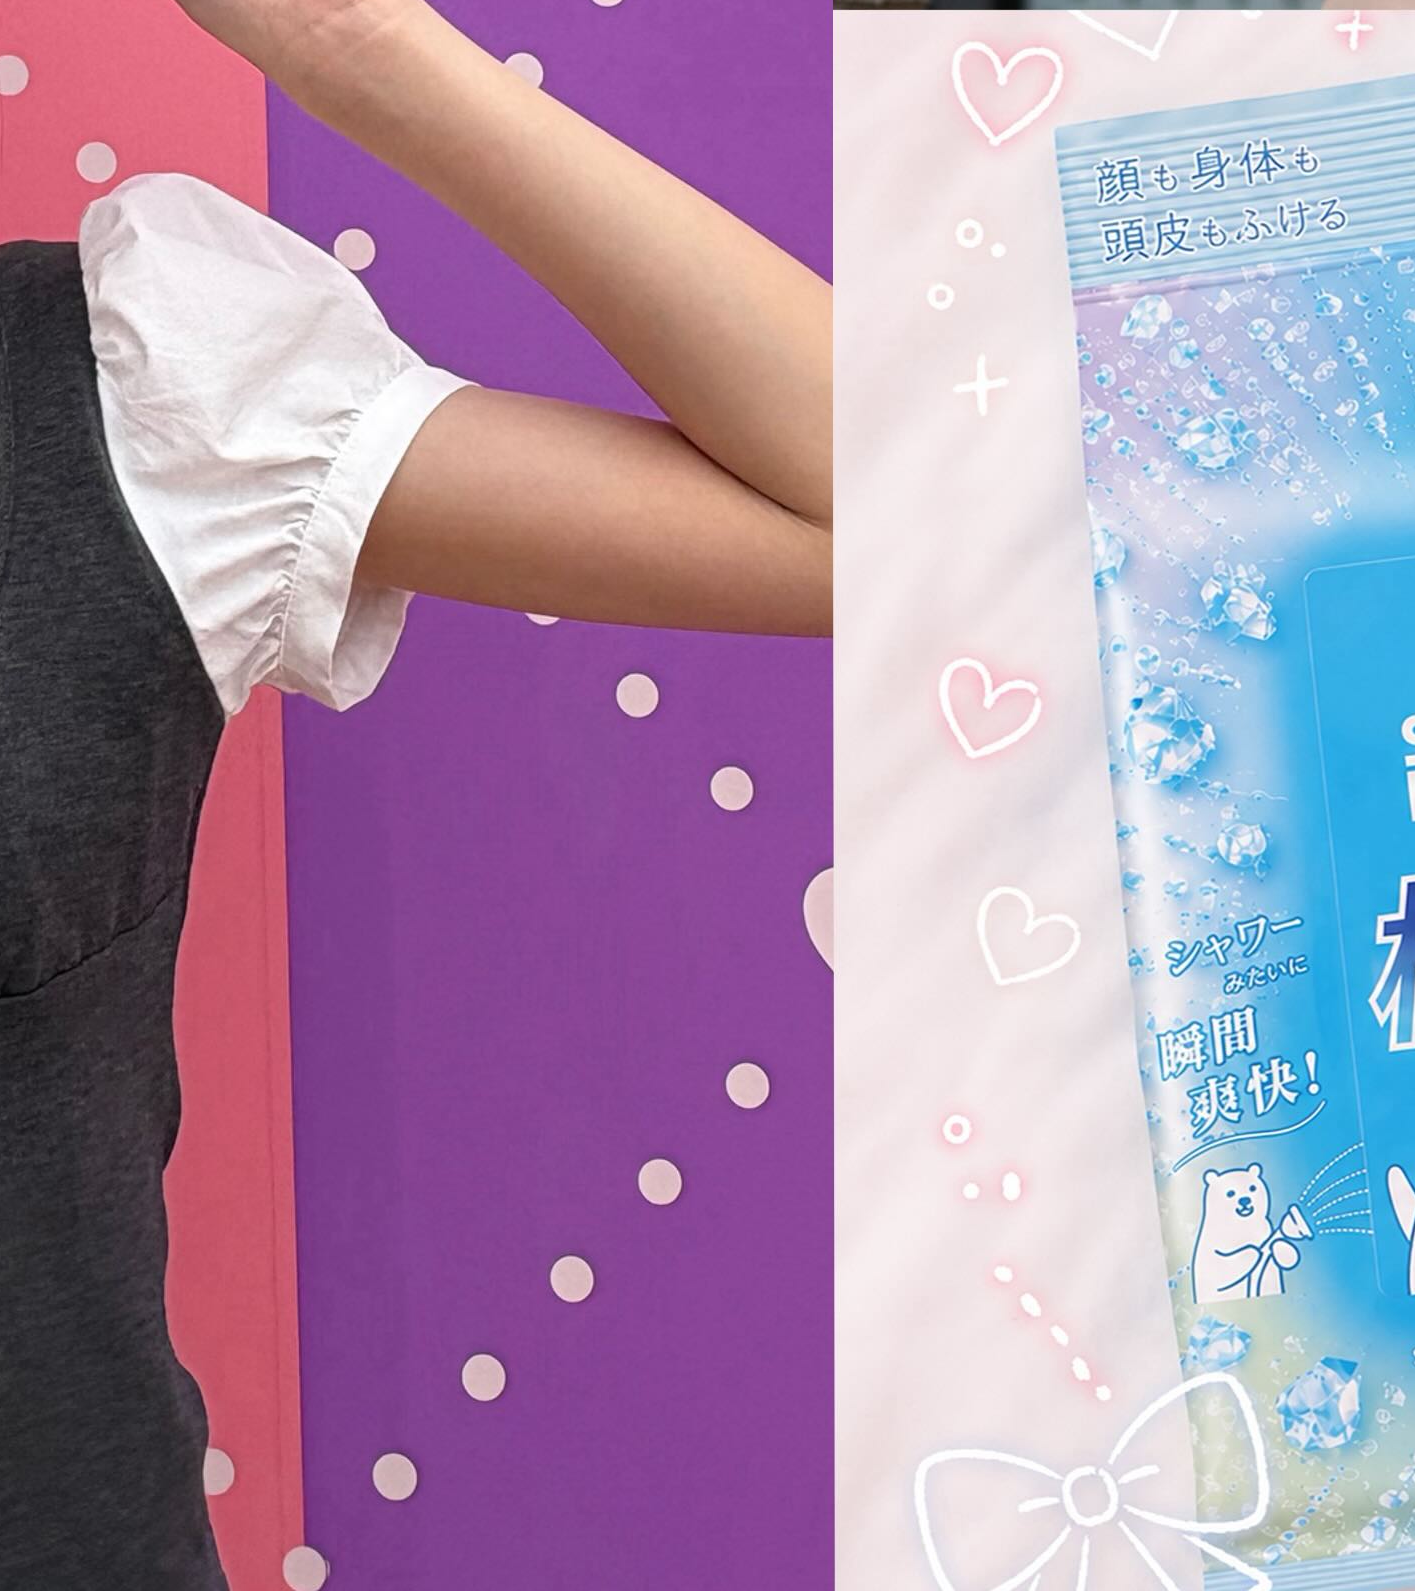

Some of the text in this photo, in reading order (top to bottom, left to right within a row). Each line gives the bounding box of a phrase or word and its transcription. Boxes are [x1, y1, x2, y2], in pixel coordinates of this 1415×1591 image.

[1095, 139, 1320, 204] 顔も身体も
[1101, 197, 1347, 262] 頭皮もふける
[1165, 915, 1304, 977] シャワー
[1223, 955, 1309, 995] みたいに
[1157, 1005, 1257, 1082] 瞬間
[1187, 1050, 1322, 1138] 爽快!
